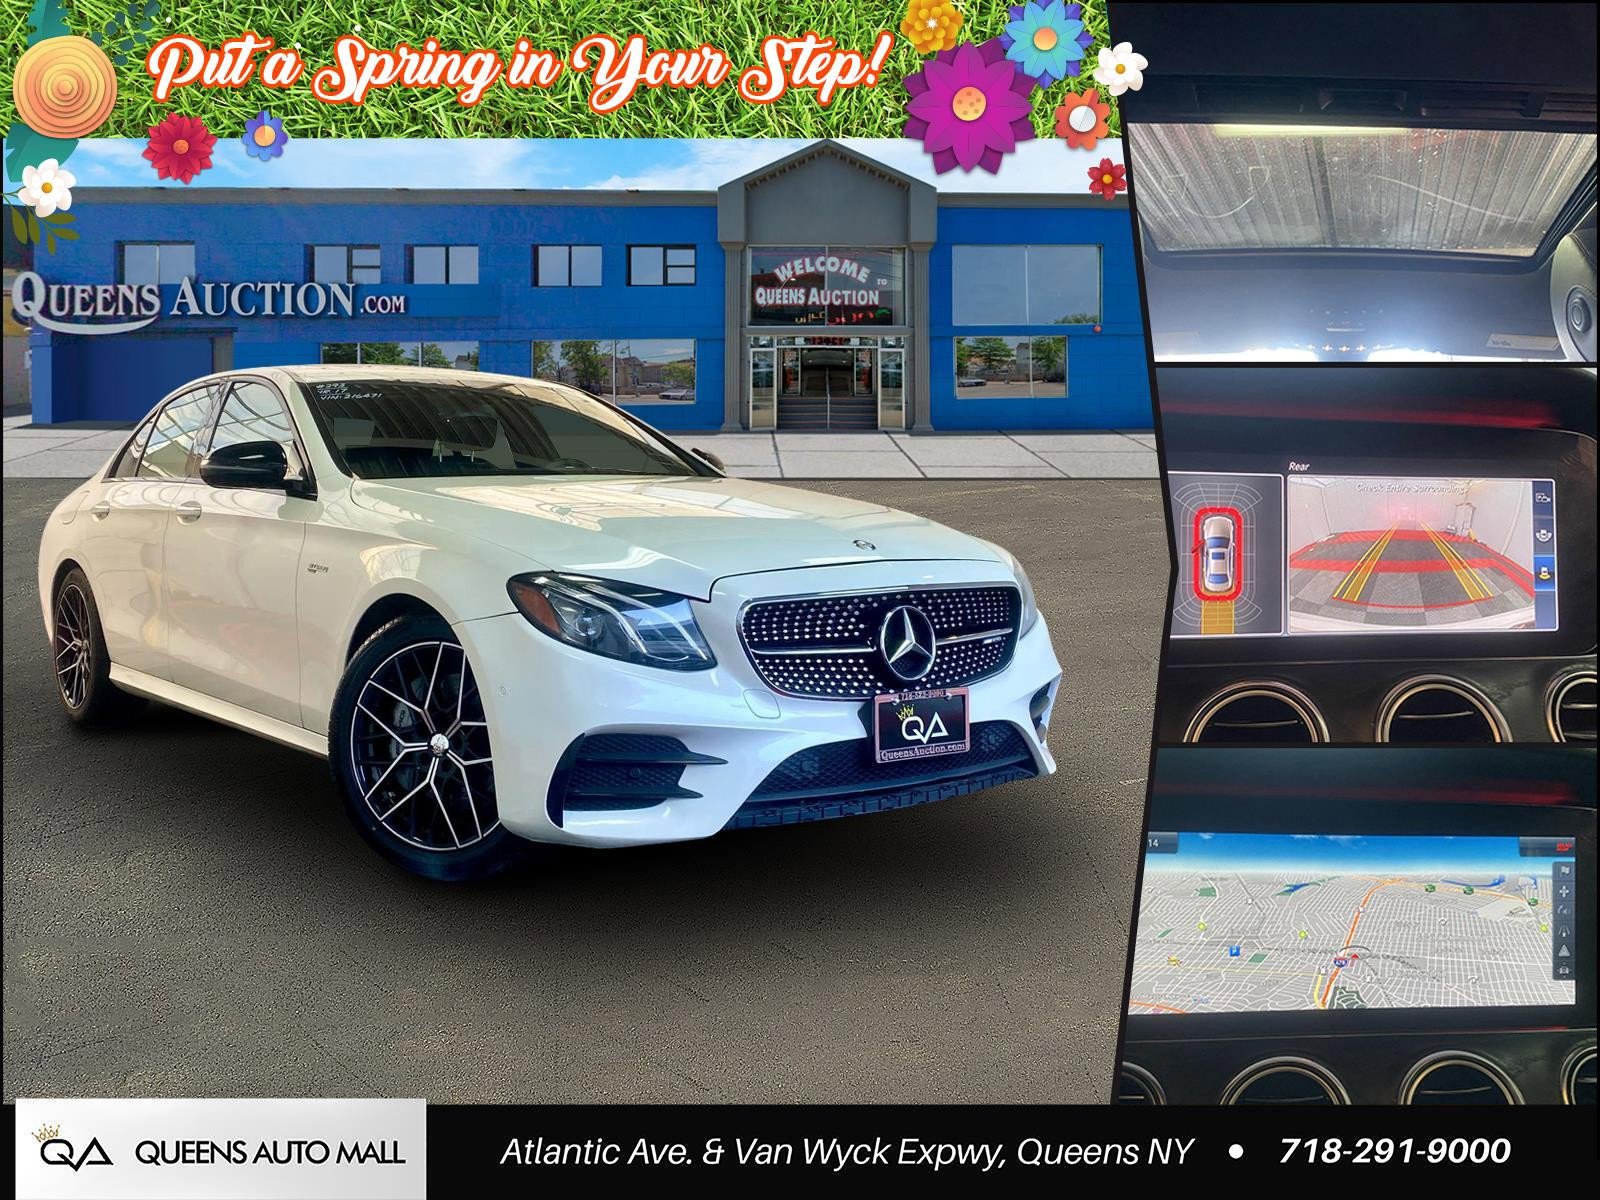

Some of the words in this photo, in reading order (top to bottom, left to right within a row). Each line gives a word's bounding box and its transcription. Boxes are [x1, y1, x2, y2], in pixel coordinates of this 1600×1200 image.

[774, 256, 870, 284] WELCOME
[12, 270, 161, 335] QUEENS
[755, 287, 807, 305] QUEENS
[808, 287, 880, 305] AUCTION
[1288, 460, 1310, 472] Rear
[901, 711, 949, 745] QA
[880, 743, 967, 761] QueensAuction.com
